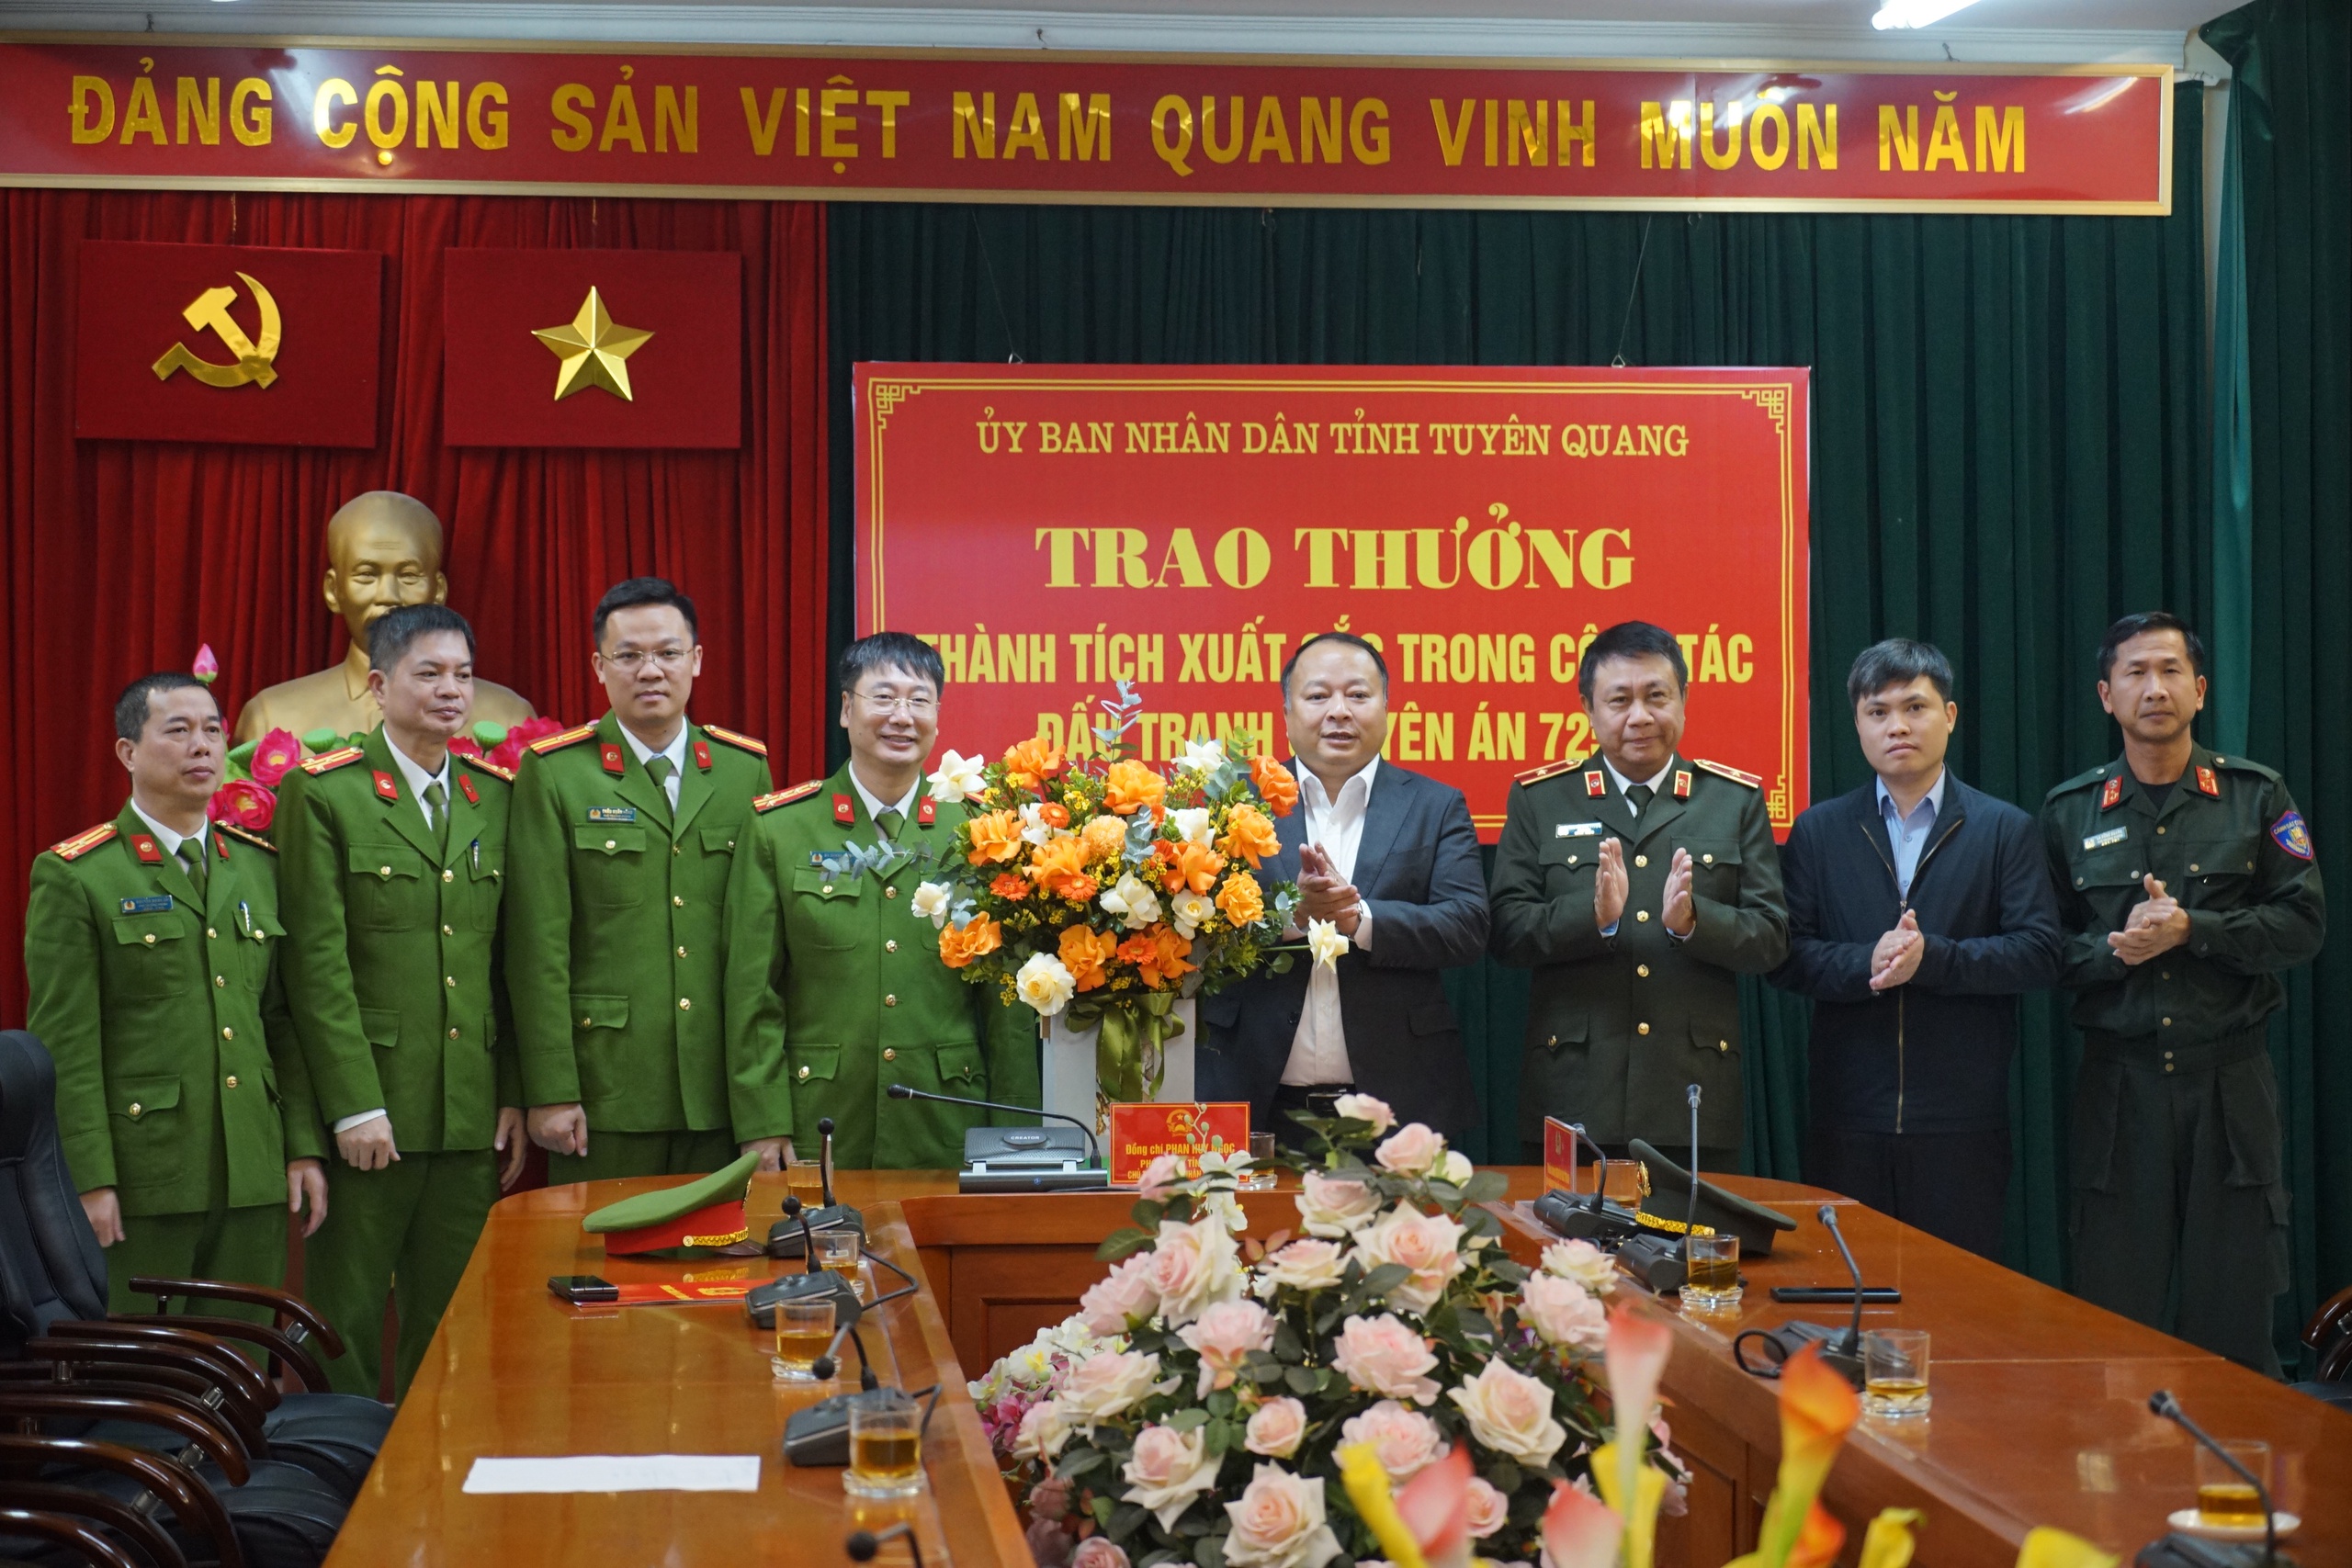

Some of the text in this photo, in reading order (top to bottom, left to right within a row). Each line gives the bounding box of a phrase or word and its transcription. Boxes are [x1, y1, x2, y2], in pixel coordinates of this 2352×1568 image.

[68, 57, 2025, 176] ĐẢNG CỘNG SẢN VIỆT NAM QUANG VINH MUÔN NĂM
[976, 406, 1690, 458] ỦY BAN NHÂN DÂN TỈNH TUYÊN QUANG
[1035, 502, 1635, 592] TRAO THƯỞNG
[915, 623, 1056, 682] HÀNH
[1070, 623, 1164, 682] TÍCH
[1179, 615, 1286, 682] XUẤT
[1398, 633, 1534, 683] TRONG
[1676, 624, 1753, 683] TÁC
[1464, 702, 1526, 761] ÁN
[1150, 1144, 1163, 1155] chí
[1166, 1144, 1190, 1155] PHAN
